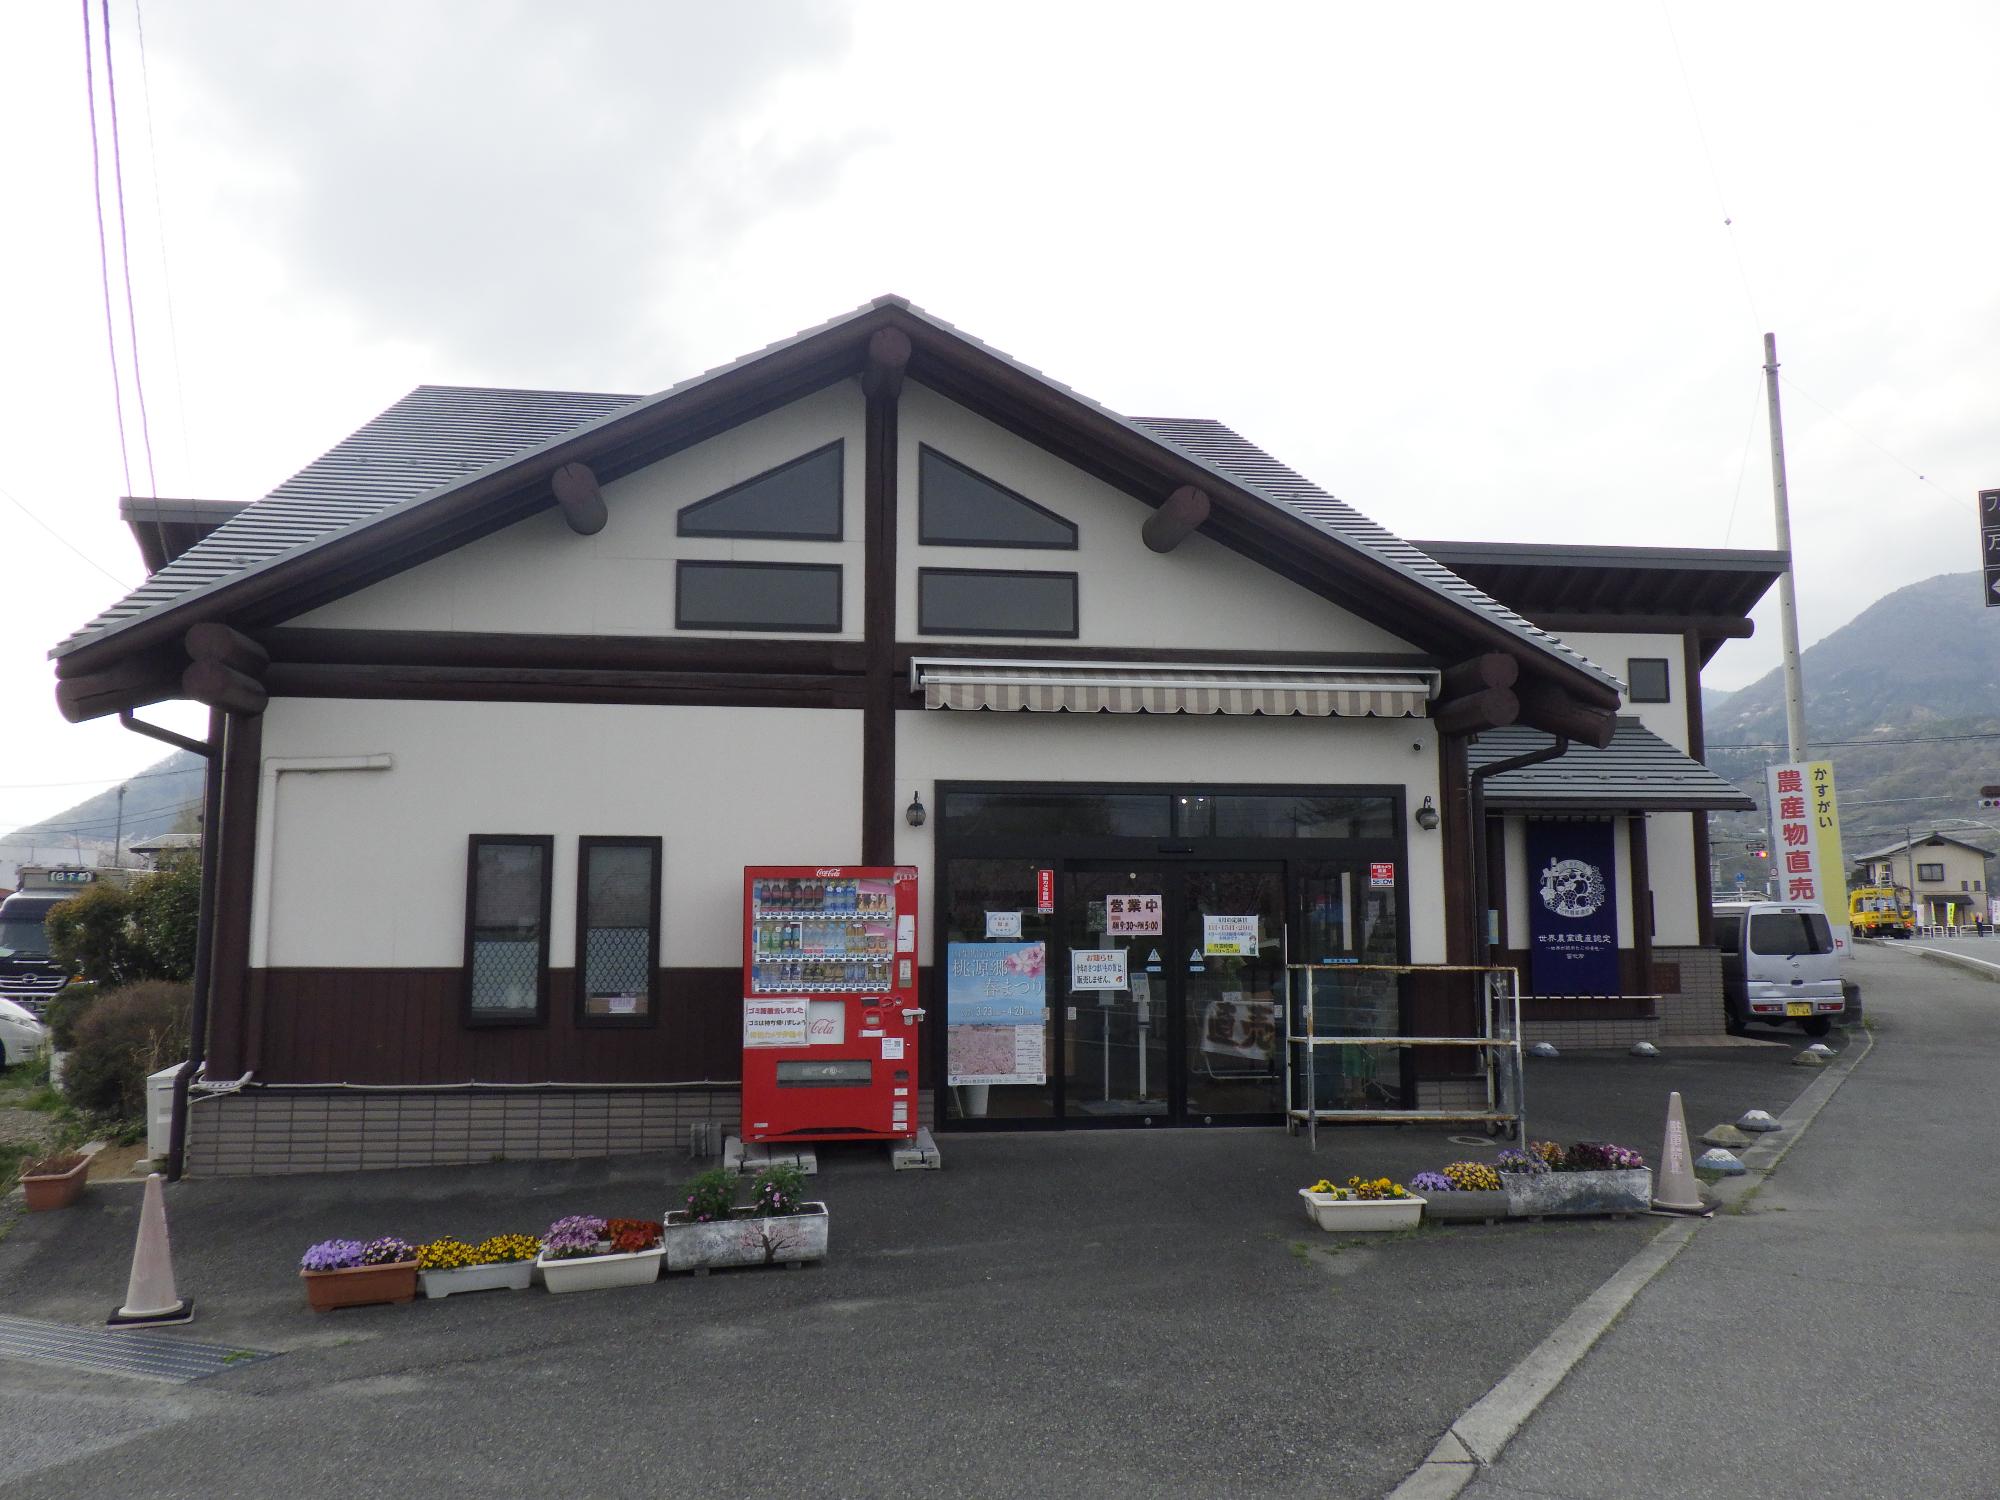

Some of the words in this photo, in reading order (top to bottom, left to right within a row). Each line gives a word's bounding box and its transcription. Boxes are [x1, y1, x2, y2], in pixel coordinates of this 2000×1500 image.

[1814, 768, 1833, 828] かすがい
[1777, 769, 1815, 900] 農産物直売
[816, 868, 841, 877] Coca-Cola
[1111, 899, 1158, 912] 営業中
[953, 959, 1008, 977] 桃源郷
